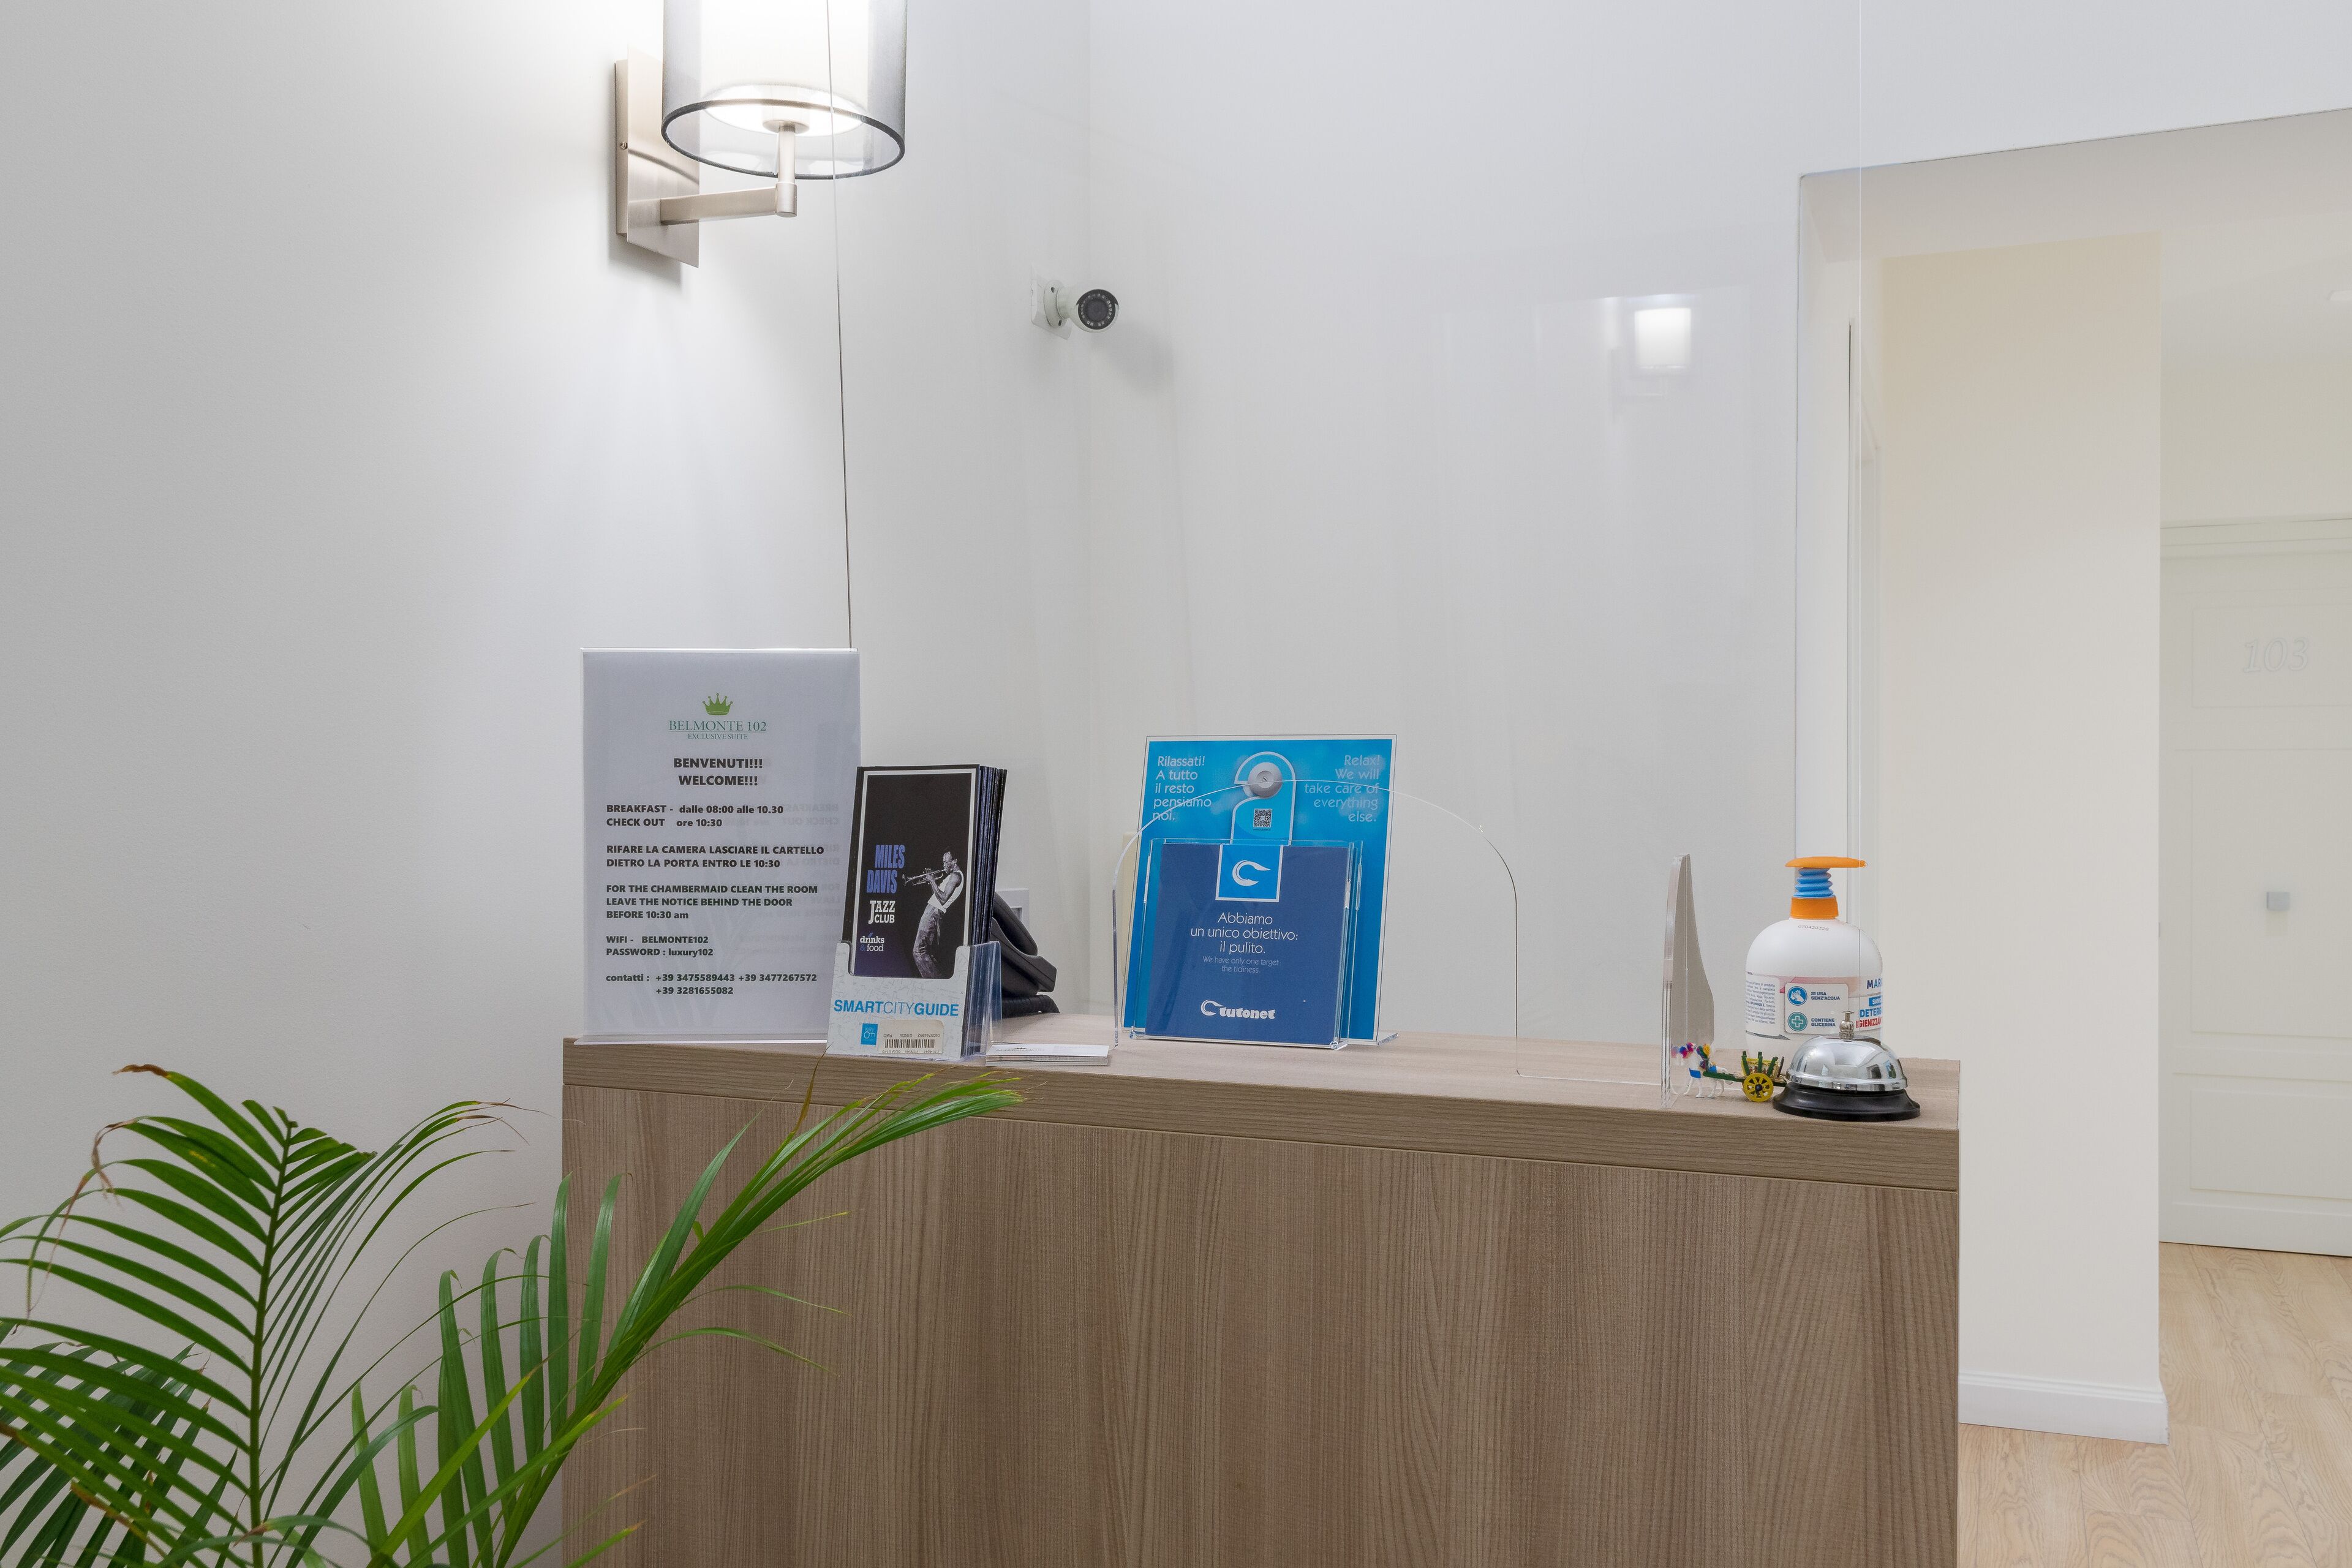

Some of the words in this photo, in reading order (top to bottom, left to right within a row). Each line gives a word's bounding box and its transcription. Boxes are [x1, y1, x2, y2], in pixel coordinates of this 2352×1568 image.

[2242, 636, 2309, 673] 103
[669, 720, 743, 731] BELMONTE
[747, 721, 767, 731] 102
[674, 758, 763, 769] BENVENUTI!!!
[1157, 755, 1205, 767] Rilassati!
[1344, 754, 1381, 766] Relax!
[1155, 769, 1166, 780] A
[1169, 769, 1198, 780] tutto
[1335, 768, 1354, 780] We
[1359, 769, 1379, 780] will
[678, 775, 758, 786] WELCOME!!!
[1155, 783, 1161, 794] il
[1164, 783, 1194, 794] resto
[1304, 783, 1331, 794] take
[1335, 784, 1362, 794] care
[1366, 782, 1380, 794] of
[1153, 796, 1212, 810] pensiamo
[1313, 797, 1379, 810] everything
[606, 804, 667, 813] BREAKFAST
[679, 805, 704, 813] dalle
[706, 805, 734, 813] 08:00
[736, 805, 755, 814] alle
[756, 805, 784, 814] 10.30
[1152, 810, 1175, 821] noi.
[1348, 810, 1377, 823] else.
[606, 818, 641, 826] CHECK
[696, 818, 723, 827] 10:30
[646, 845, 659, 854] LA
[662, 845, 706, 854] CAMERA
[709, 846, 758, 854] LASCIARE
[761, 846, 770, 854] IL
[772, 846, 824, 854] CARTELLO
[875, 844, 905, 869] MILES
[606, 859, 645, 867] DIETRO
[647, 859, 661, 867] LA
[664, 859, 699, 867] PORTA
[702, 859, 737, 868] ENTRO
[740, 859, 751, 868] LE
[753, 859, 780, 868] 10:30
[866, 870, 898, 894] DAVIS
[628, 884, 649, 893] THE
[650, 884, 728, 893] CHAMBERMAID
[730, 885, 763, 894] CLEAN
[764, 885, 785, 894] THE
[787, 885, 818, 894] ROOM
[606, 897, 637, 906] LEAVE
[639, 897, 659, 906] THE
[701, 898, 739, 907] BEHIND
[741, 898, 761, 907] THE
[763, 898, 793, 907] DOOR
[606, 910, 644, 919] BEFORE
[868, 900, 896, 924] JAZZ
[874, 914, 895, 924] CLUB
[1217, 911, 1273, 925] Abbiamo
[859, 933, 885, 944] drinks
[1190, 927, 1204, 937] un
[1207, 926, 1240, 938] unico
[1243, 927, 1298, 941] obiettivo:
[668, 948, 714, 958] luxury102
[867, 943, 884, 952] food
[1219, 940, 1226, 952] il
[1229, 941, 1265, 955] pulito.
[606, 973, 644, 982] contatti
[655, 973, 674, 982] +39
[676, 973, 735, 982] 3475589443
[656, 986, 674, 995] +39
[677, 986, 734, 995] 3281655082
[834, 999, 960, 1017] SMARTCITYGUIDE
